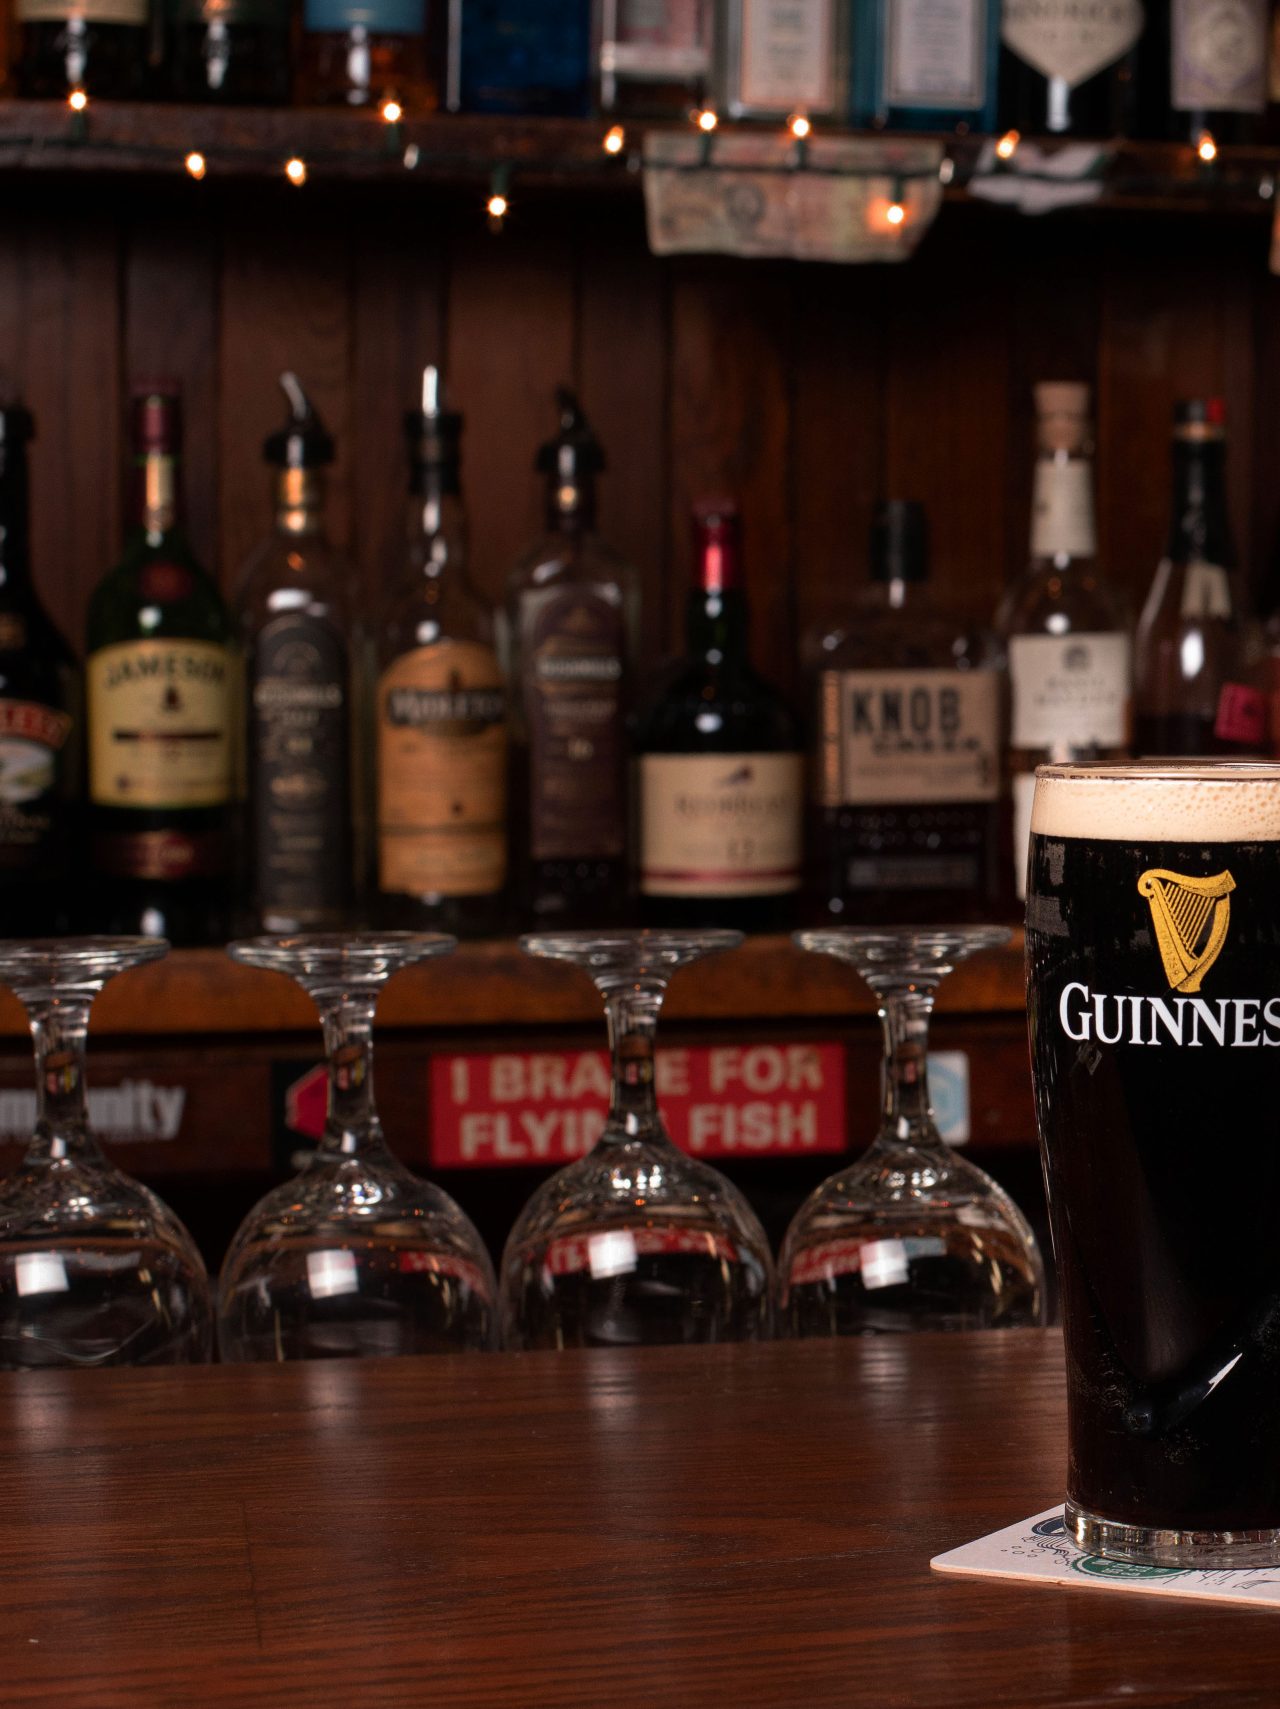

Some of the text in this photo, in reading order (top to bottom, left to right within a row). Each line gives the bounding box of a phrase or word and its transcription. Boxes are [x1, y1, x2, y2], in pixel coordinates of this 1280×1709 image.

[851, 686, 963, 738] KNOB
[452, 1045, 823, 1104] I BRAE FOR
[460, 1099, 820, 1160] FLYIN FISH
